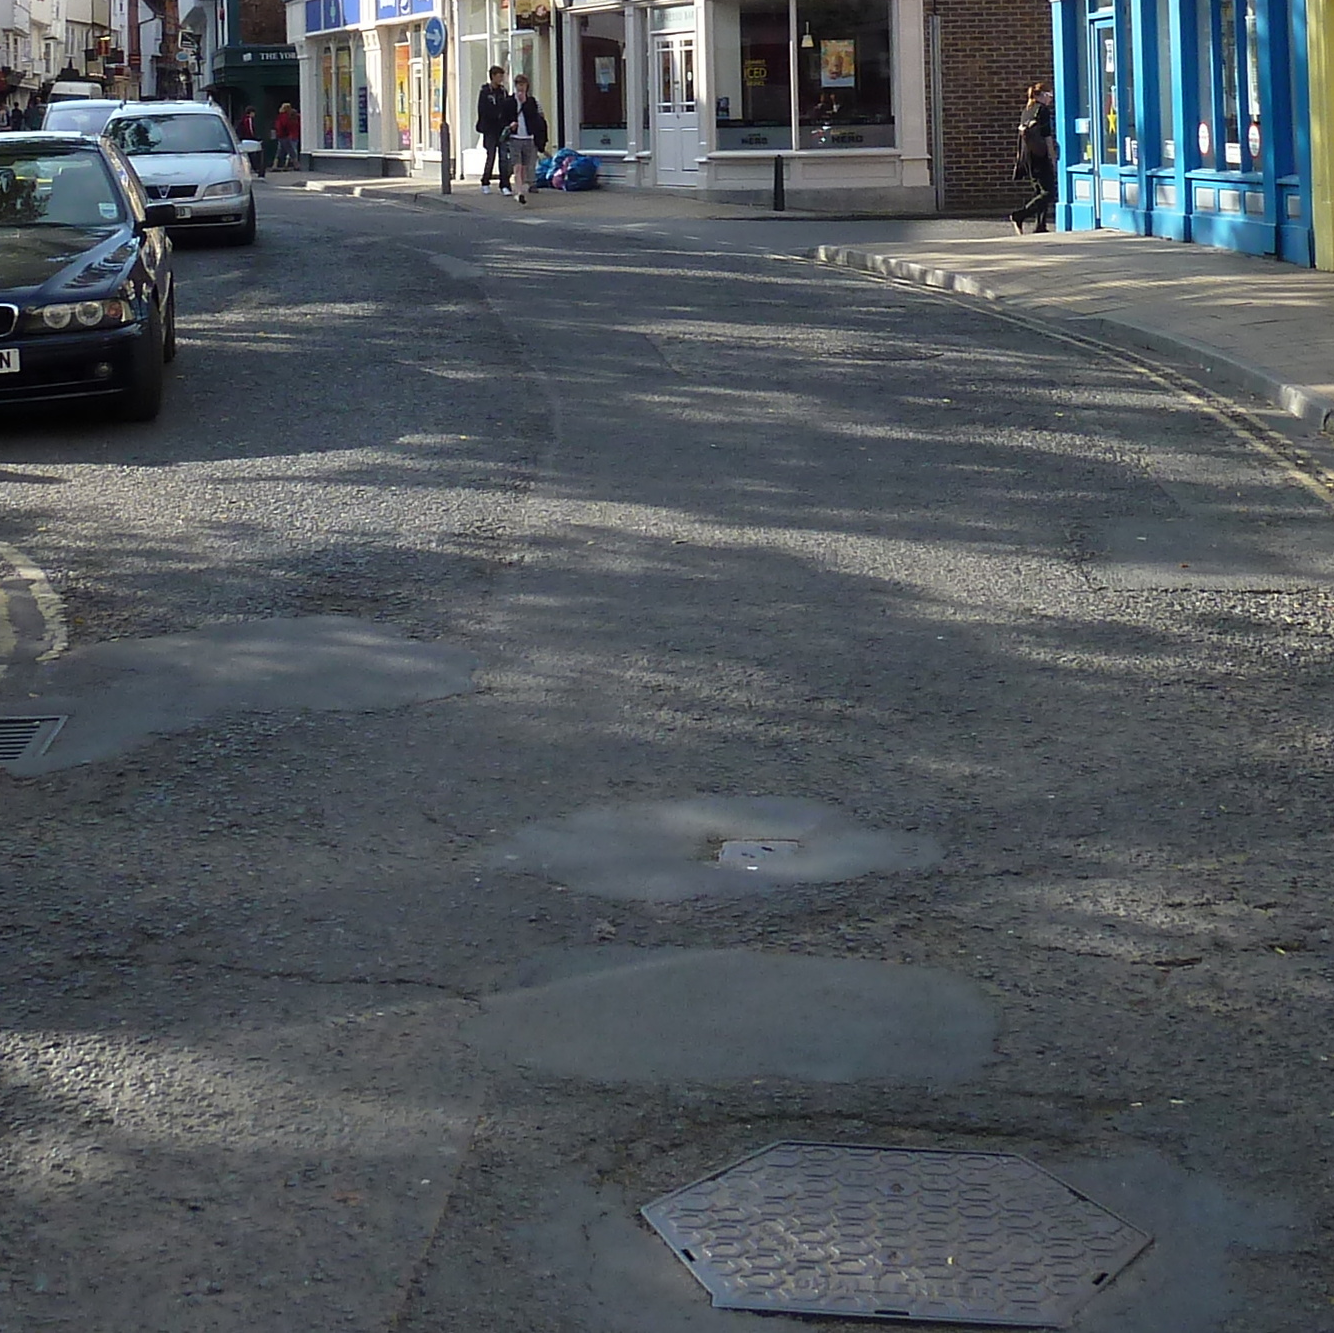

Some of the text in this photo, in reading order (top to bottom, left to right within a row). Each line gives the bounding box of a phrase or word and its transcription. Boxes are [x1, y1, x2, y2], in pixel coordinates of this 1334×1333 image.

[259, 51, 278, 61] THE
[744, 67, 767, 80] ICED
[741, 137, 768, 145] NERO
[831, 134, 864, 143] NERO
